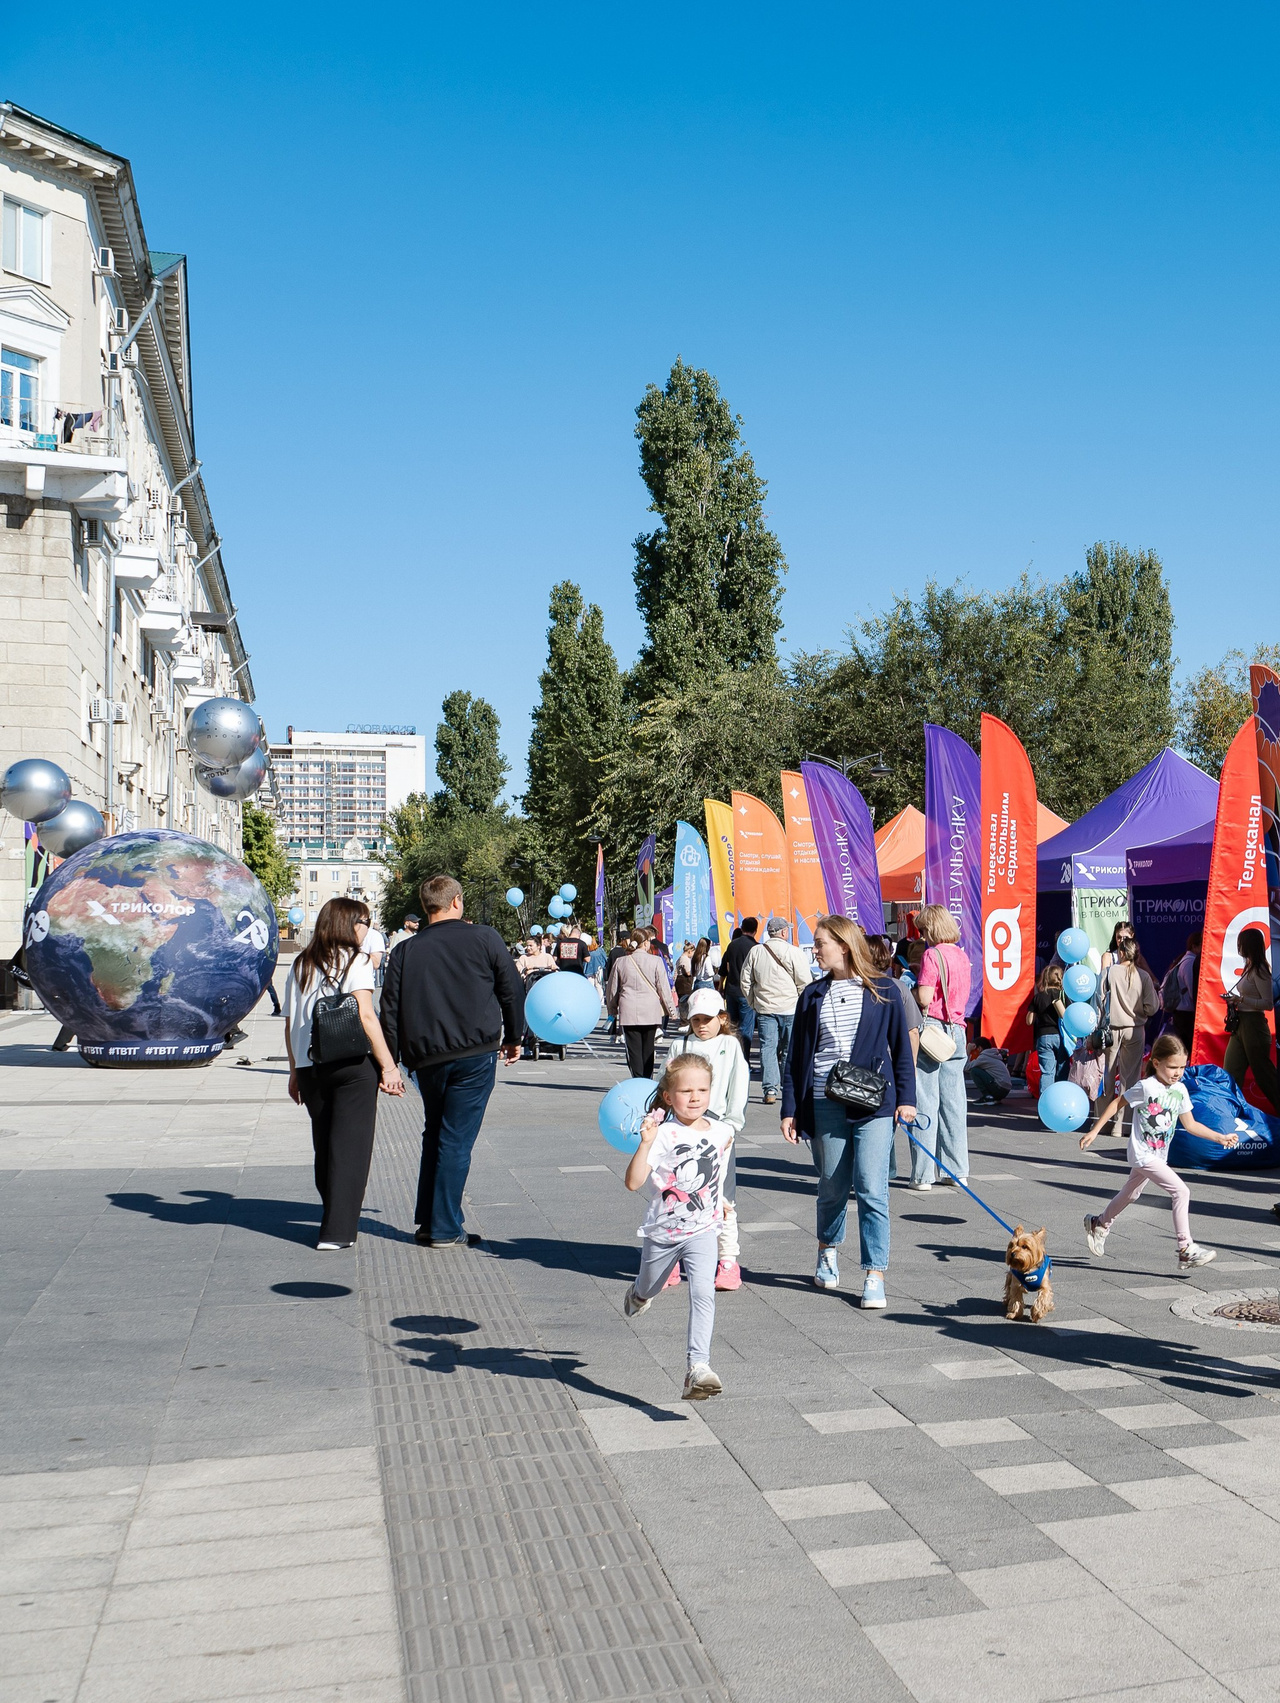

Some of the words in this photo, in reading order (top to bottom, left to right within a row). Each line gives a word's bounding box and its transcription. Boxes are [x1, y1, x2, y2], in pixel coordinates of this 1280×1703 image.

[997, 792, 1010, 865] большим
[1237, 795, 1262, 891] Телеканал
[986, 813, 998, 896] Телеканал
[1007, 819, 1018, 885] сердцем
[1089, 865, 1126, 874] ТРИКОЛО
[1133, 859, 1153, 868] ТРИКОЛОР
[1060, 862, 1072, 884] 20
[111, 901, 196, 917] ТРИКОЛОР
[1080, 895, 1127, 908] ТРИКО
[1089, 910, 1120, 919] твоем
[1145, 914, 1177, 923] твоем
[232, 910, 269, 950] 20
[108, 1046, 140, 1056] #ТВТГ
[145, 1046, 178, 1056] #ТВТГ
[182, 1044, 209, 1055] #ТВТГ
